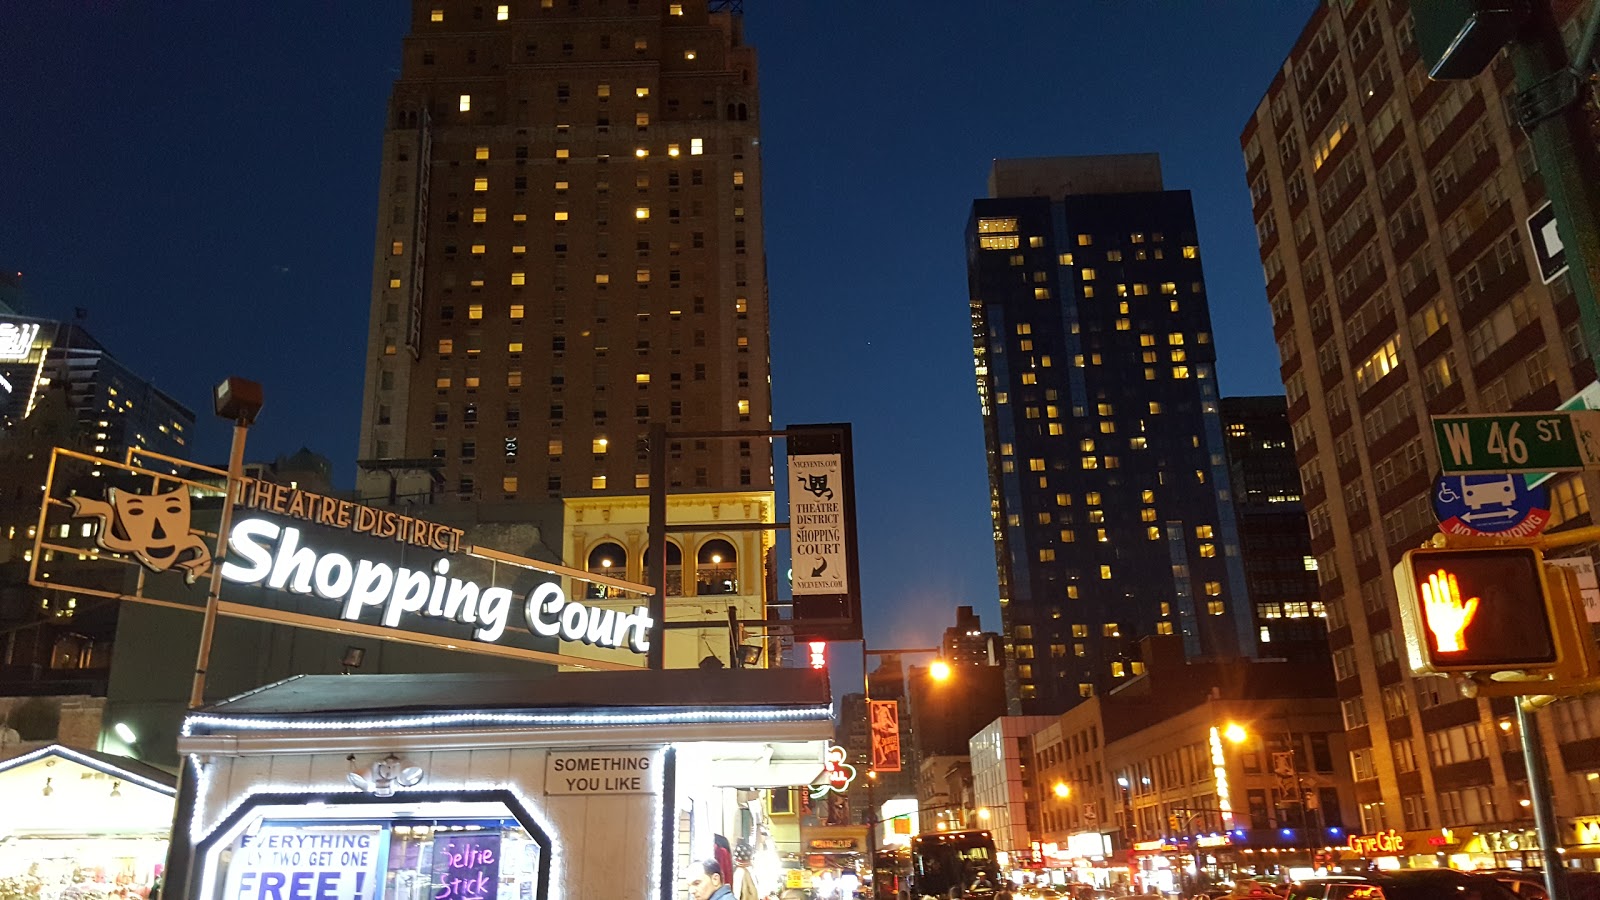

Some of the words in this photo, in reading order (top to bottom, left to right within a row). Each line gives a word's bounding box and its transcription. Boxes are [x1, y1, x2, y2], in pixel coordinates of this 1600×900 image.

[1443, 423, 1473, 466] W
[1487, 421, 1529, 465] 46
[1536, 419, 1562, 442] ST
[235, 477, 350, 528] THEATRE
[354, 504, 465, 552] DISTRICT
[796, 503, 838, 513] THEATRE
[797, 514, 839, 524] DISTRICT
[797, 529, 840, 542] SHOPPING
[797, 544, 840, 555] COURT
[221, 518, 512, 642] Shopping
[525, 581, 654, 652] Court
[554, 757, 649, 771] SOMETHING
[566, 778, 600, 791] YOU
[605, 777, 641, 790] LIKE
[273, 852, 301, 866] TWO
[309, 851, 333, 866] GET
[341, 851, 368, 866] ONE
[440, 843, 495, 868] Selfie
[435, 871, 490, 900] Stick
